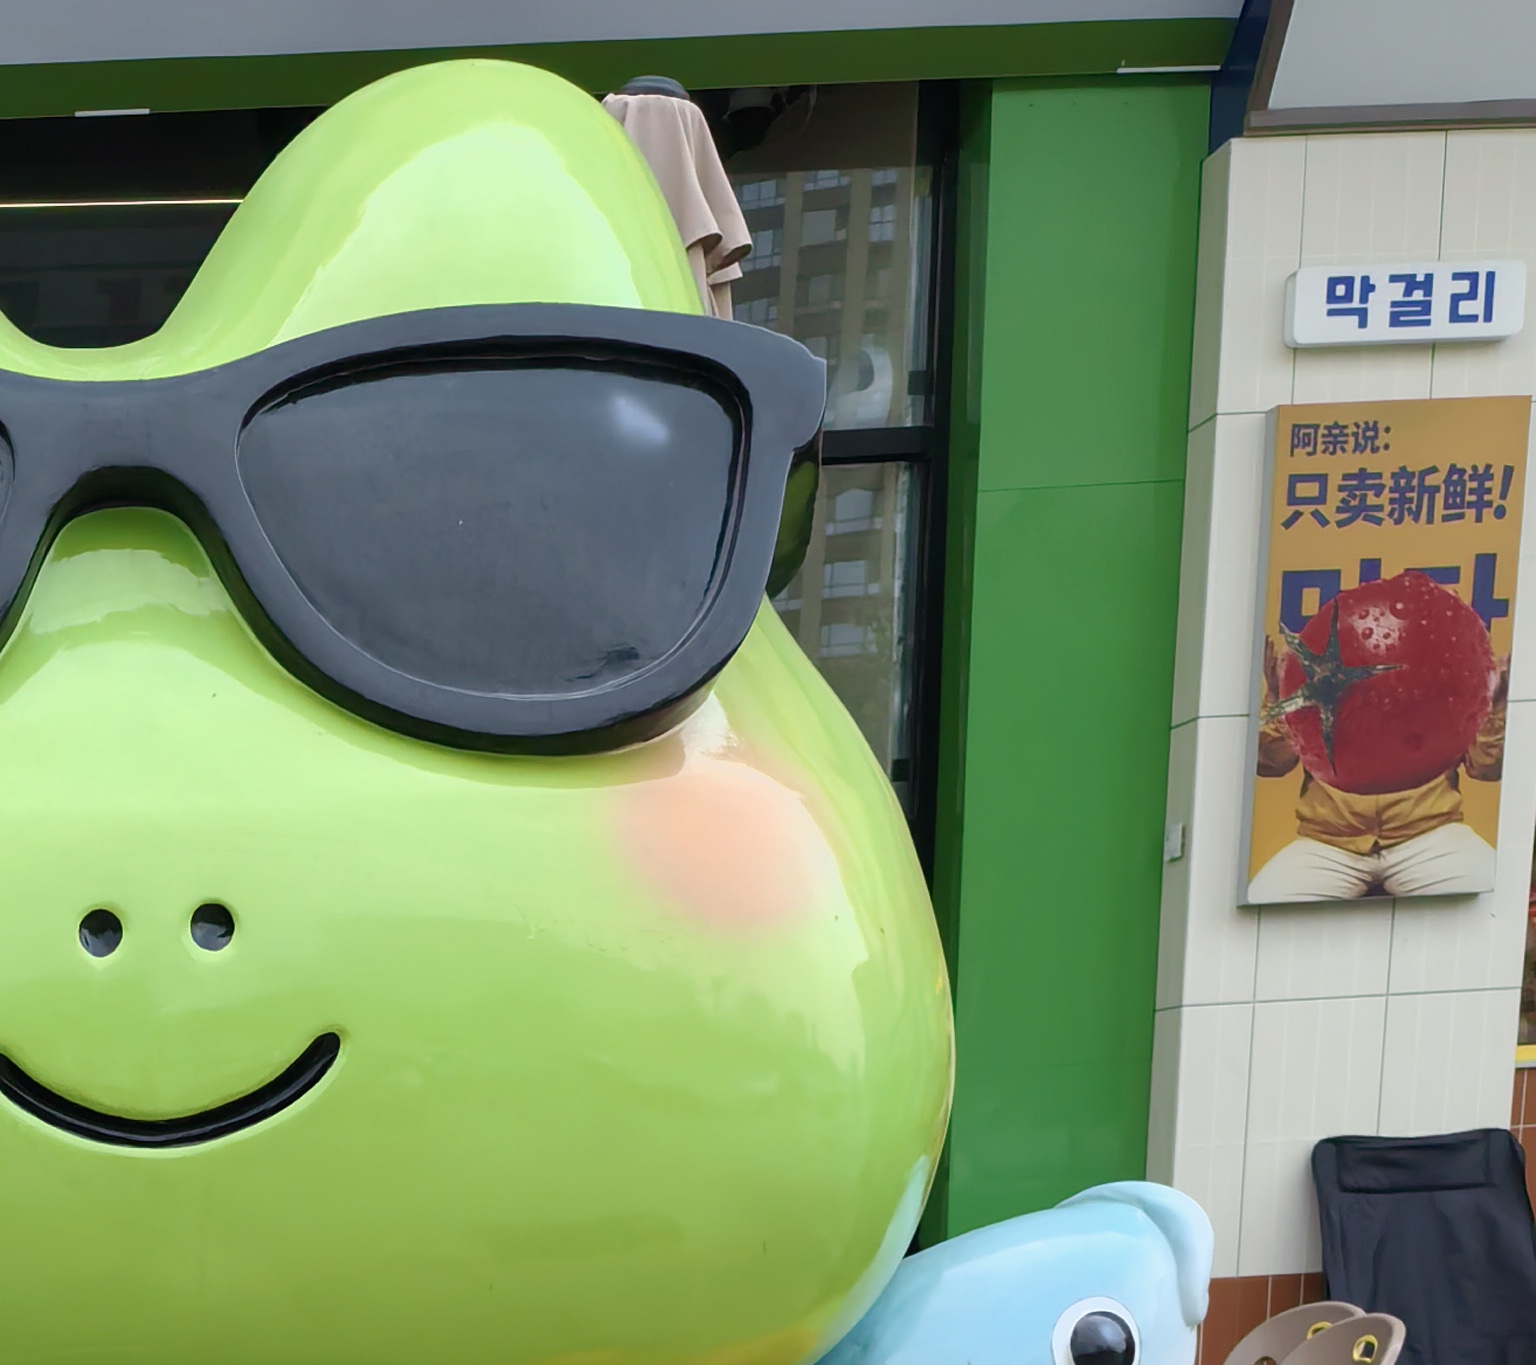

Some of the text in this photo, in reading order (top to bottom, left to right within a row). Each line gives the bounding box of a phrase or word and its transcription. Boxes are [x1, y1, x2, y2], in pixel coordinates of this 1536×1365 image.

[1326, 271, 1496, 329] 막걸리
[1290, 421, 1392, 457] 阿亲说:
[1281, 463, 1515, 530] 只卖新鲜!
